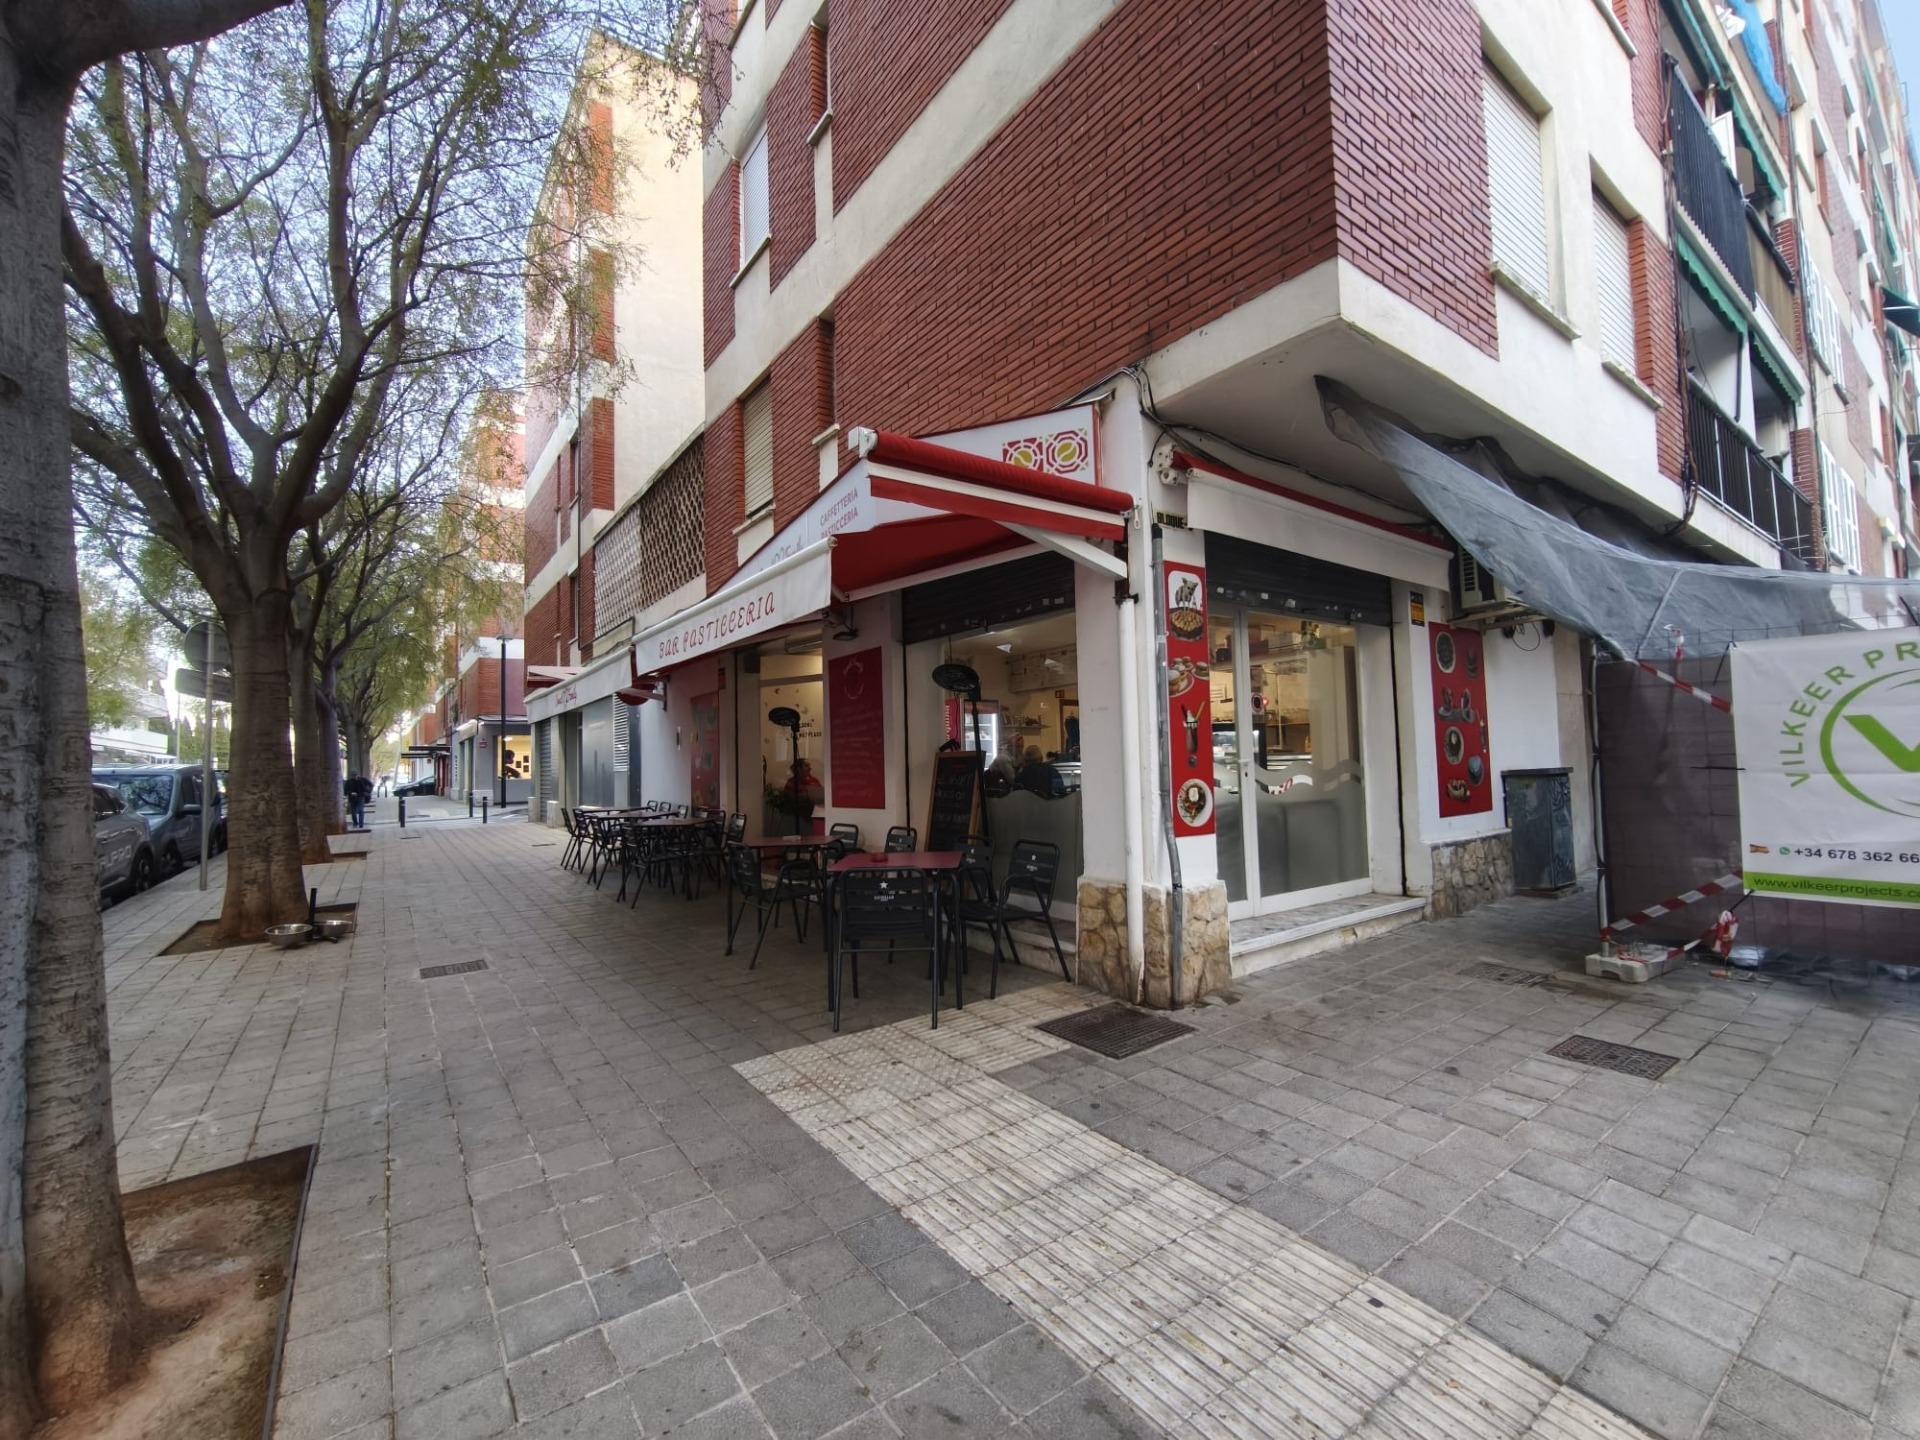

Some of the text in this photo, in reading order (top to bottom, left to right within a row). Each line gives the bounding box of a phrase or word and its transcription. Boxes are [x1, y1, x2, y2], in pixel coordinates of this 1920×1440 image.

[820, 487, 858, 526] CAFFETTERIA
[658, 591, 776, 660] BAR PASTICCERIA
[1779, 665, 1855, 788] VILKEER
[1794, 847, 1920, 864] +34 678 362 66
